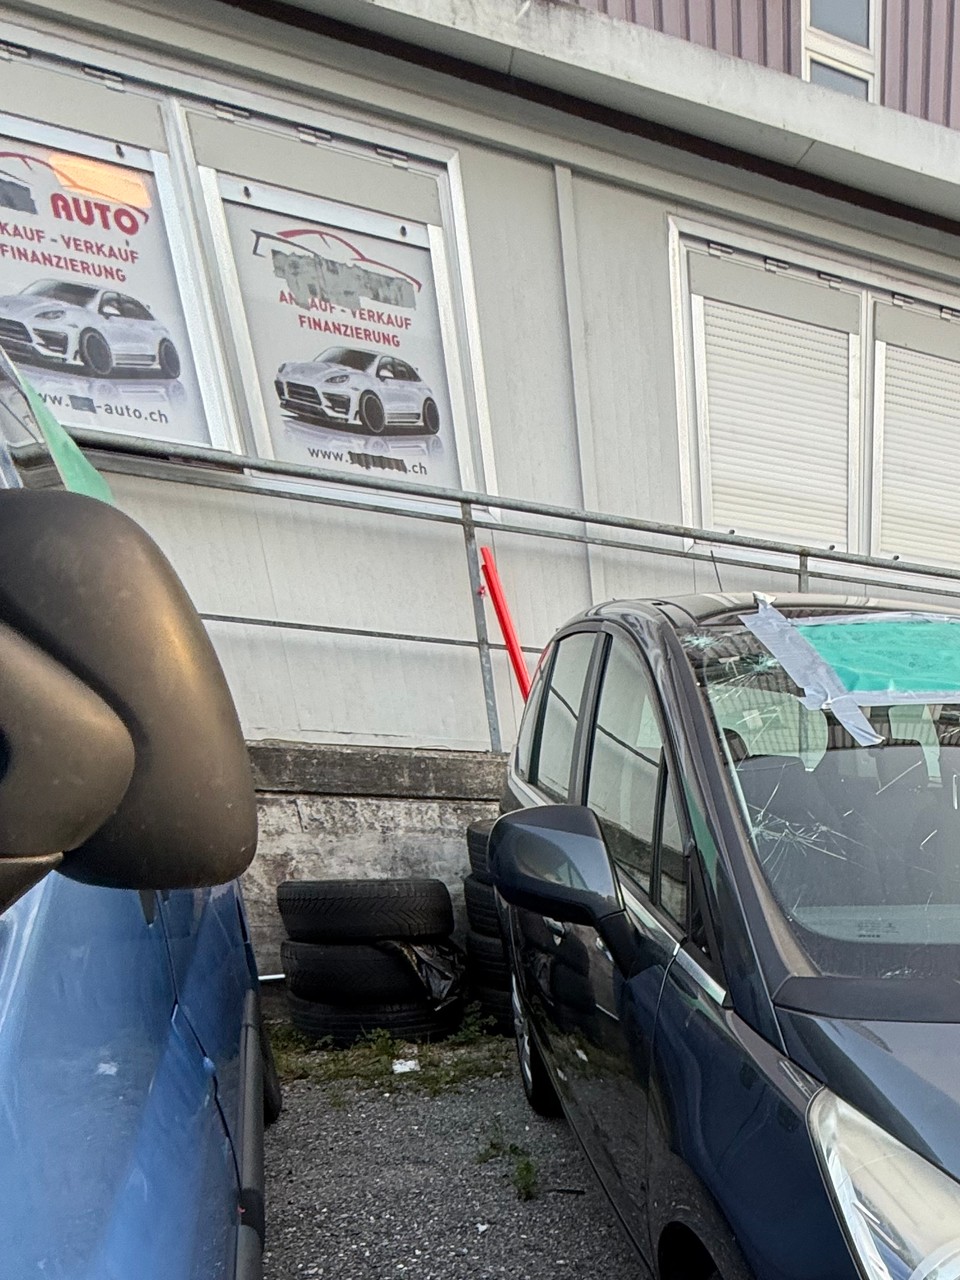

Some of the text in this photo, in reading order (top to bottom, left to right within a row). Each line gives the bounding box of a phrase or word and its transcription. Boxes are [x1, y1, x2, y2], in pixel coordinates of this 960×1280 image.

[50, 192, 139, 235] AUTO
[0, 243, 126, 282] FINANZIERUNG
[60, 233, 139, 264] VERKAUF
[279, 289, 336, 314] ANAUF
[298, 314, 400, 347] FINANZIERUNG
